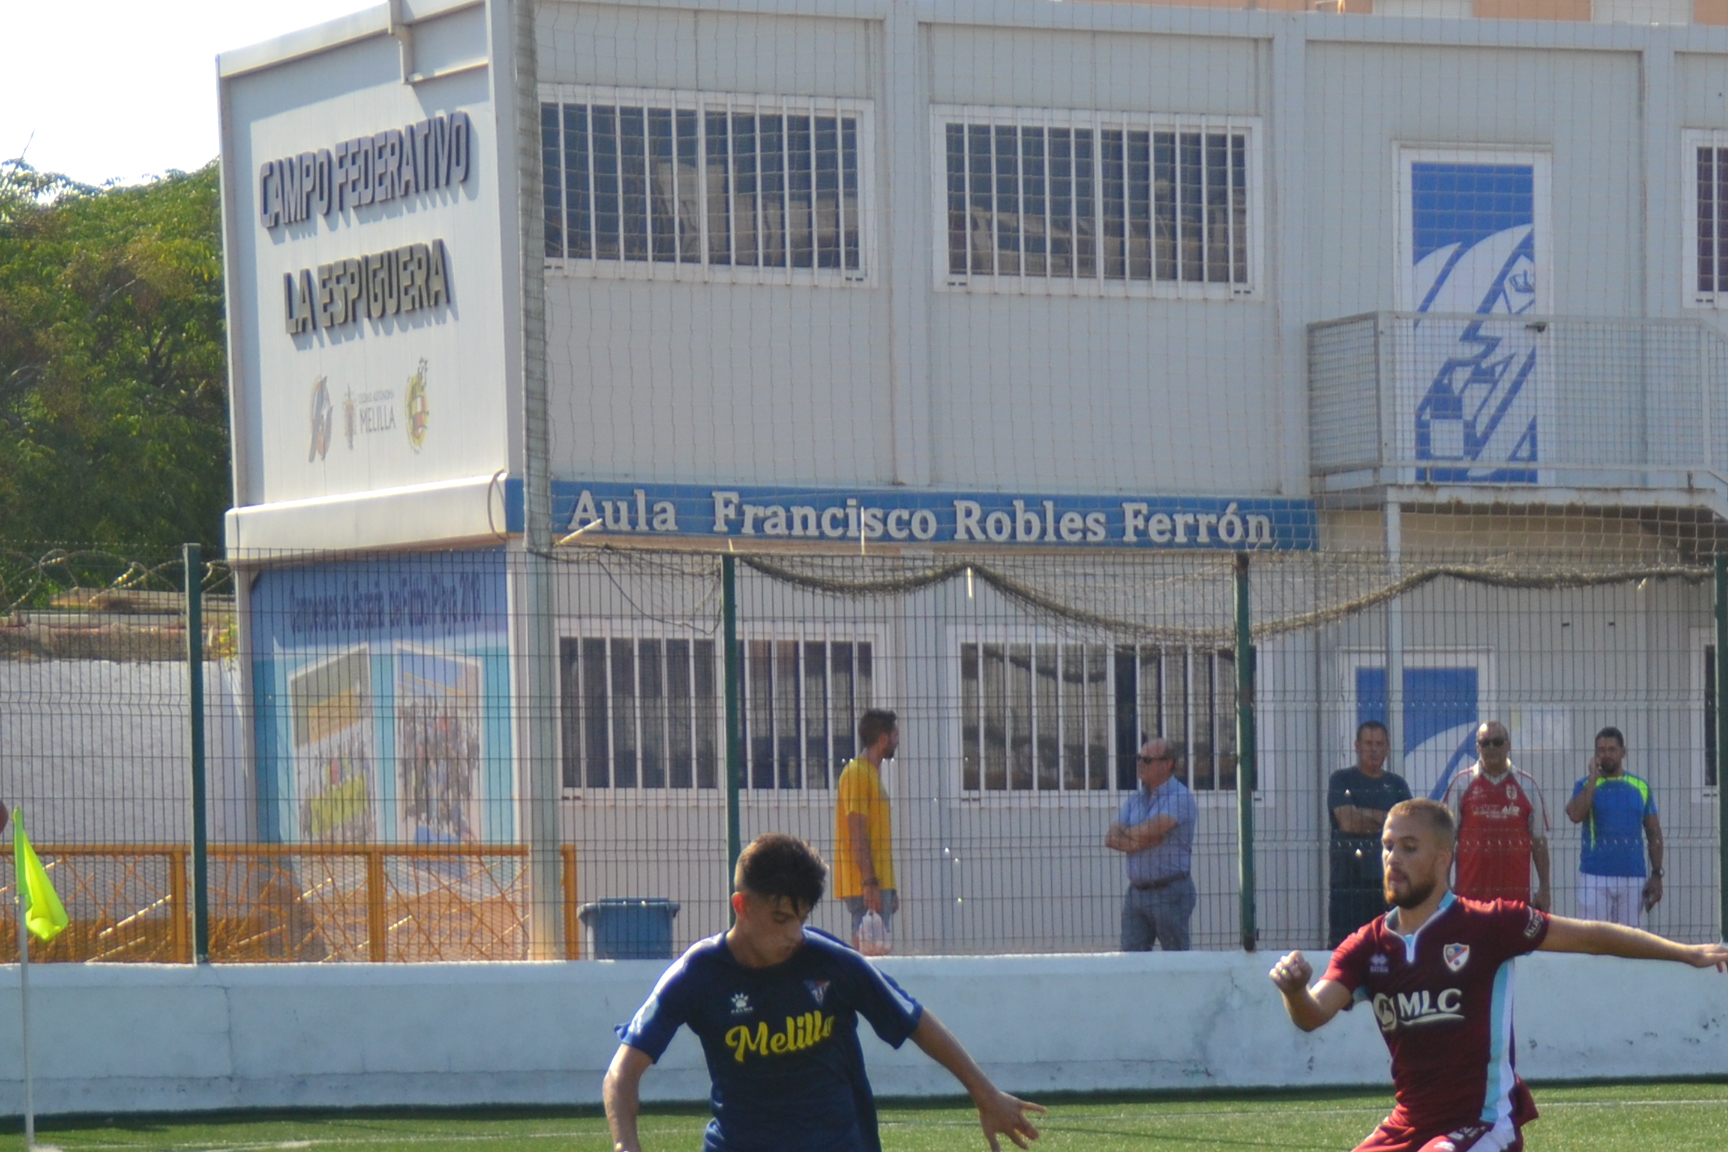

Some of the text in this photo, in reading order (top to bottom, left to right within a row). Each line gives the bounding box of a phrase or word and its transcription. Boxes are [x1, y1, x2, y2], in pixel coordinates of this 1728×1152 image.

[260, 111, 471, 229] CAMPO FEDERATIVO
[283, 238, 450, 335] LA ESPIGUERA
[359, 404, 397, 434] MELILLA
[567, 489, 1273, 544] Aula Francisco Robles Ferrón
[1397, 987, 1463, 1018] MLC
